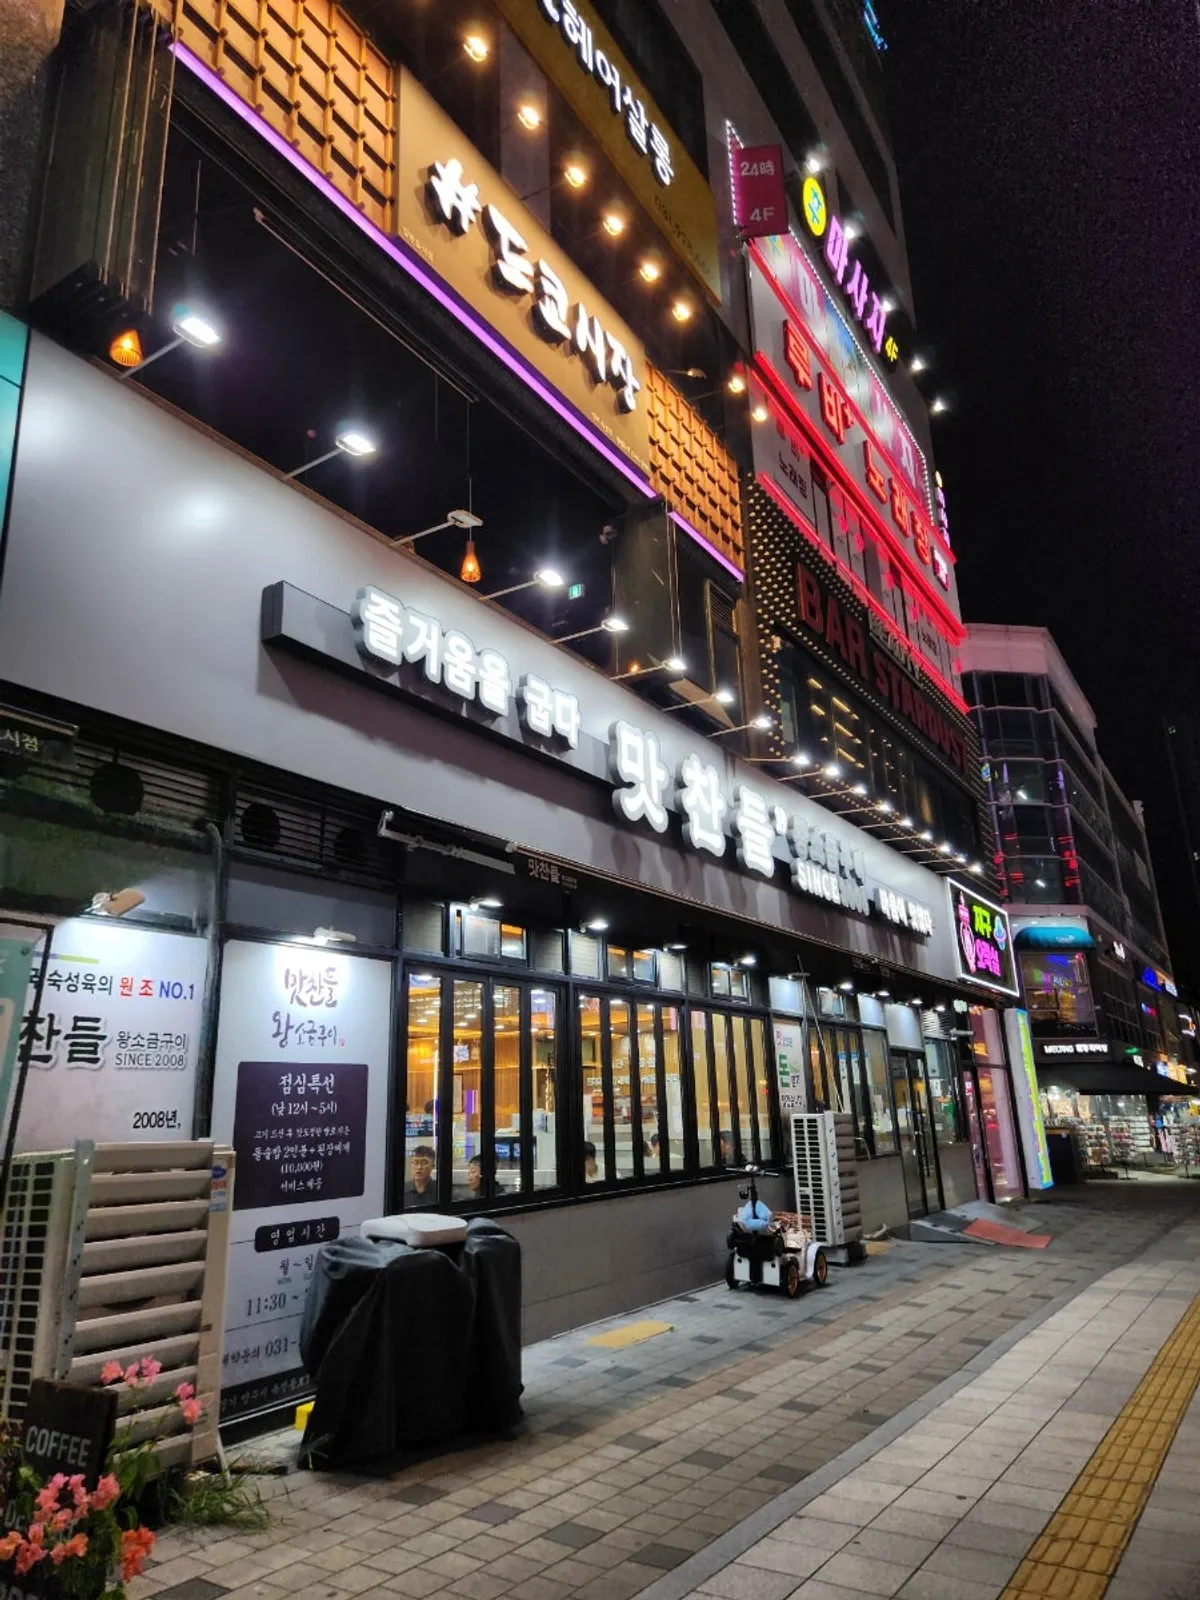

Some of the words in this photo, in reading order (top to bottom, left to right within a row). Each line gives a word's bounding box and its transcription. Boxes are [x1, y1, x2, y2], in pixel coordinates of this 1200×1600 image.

[750, 207, 775, 222] 4F
[826, 215, 888, 353] 마사지
[361, 585, 511, 717] 즐거움을
[522, 676, 580, 750] 굽다
[797, 563, 868, 682] BAR
[873, 651, 978, 775] STARDUST
[159, 980, 195, 1000] NO.1
[284, 966, 339, 1008] 맛찬들
[116, 1031, 188, 1051] 왕소금구이
[115, 1053, 151, 1067] SINCE
[155, 1054, 185, 1067] 2008
[279, 1073, 336, 1095] 점심특선
[246, 1292, 287, 1316] 11:30
[25, 1425, 92, 1467] COFFEE
